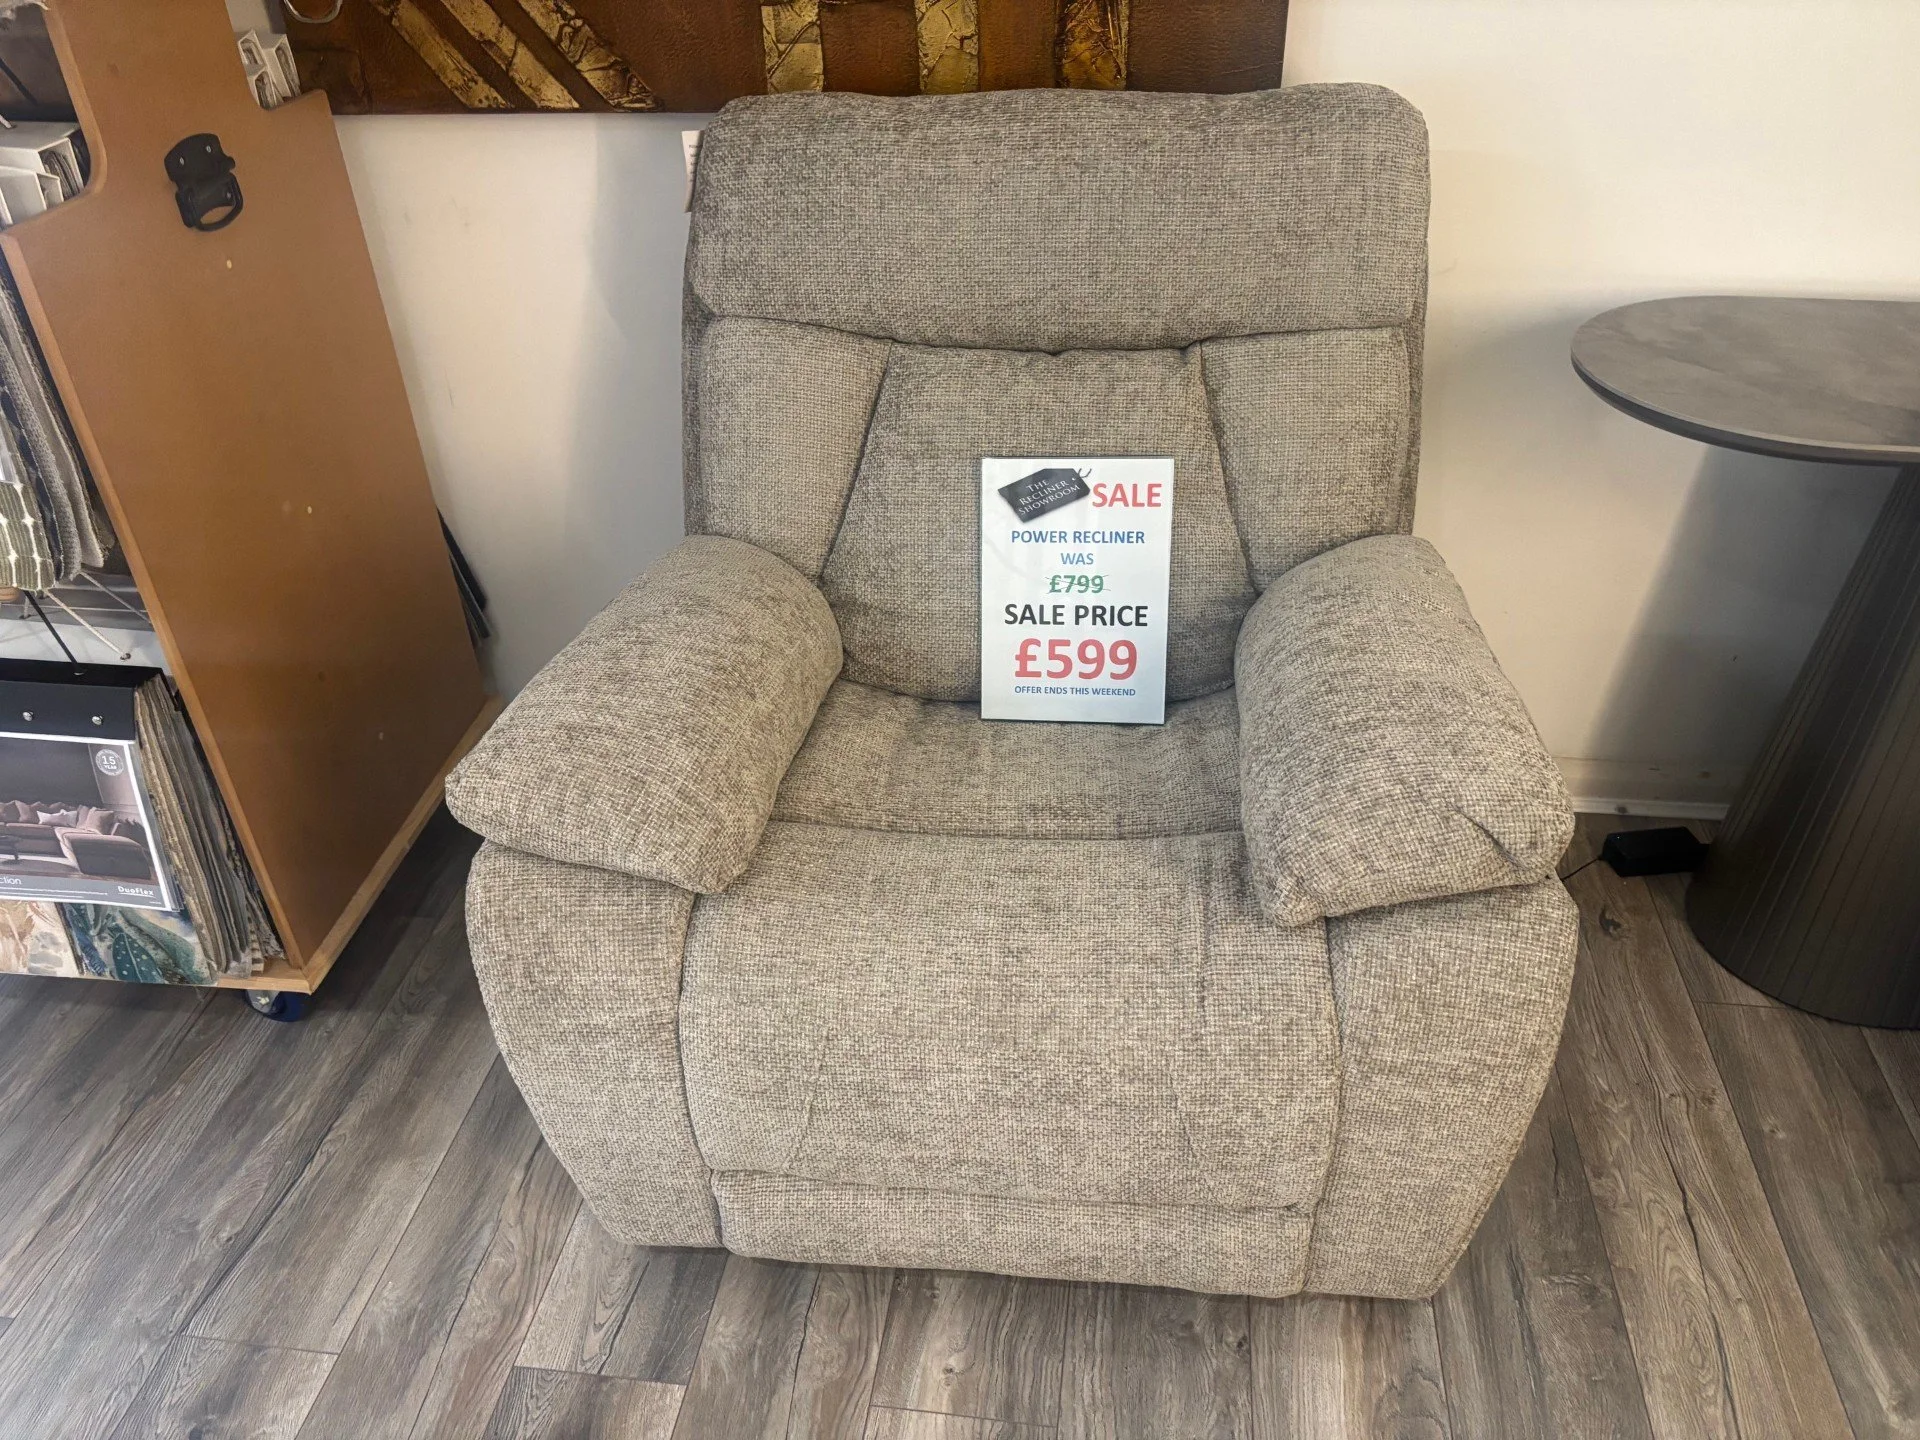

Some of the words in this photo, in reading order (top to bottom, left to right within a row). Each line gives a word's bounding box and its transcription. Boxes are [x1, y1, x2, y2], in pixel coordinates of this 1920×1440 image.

[1019, 480, 1070, 505] RECLINER
[1026, 479, 1050, 492] THE
[1092, 482, 1162, 507] SALE
[1018, 484, 1080, 515] SHOWROOM
[1011, 530, 1068, 543] POWER
[1073, 531, 1145, 544] RECLINER
[1060, 552, 1094, 565] WAS
[1049, 574, 1104, 594] £799
[1004, 603, 1065, 626] SALE
[1074, 605, 1148, 627] PRICE
[1015, 638, 1137, 680] £599
[1014, 685, 1042, 694] OFFER
[1044, 686, 1068, 695] ENDS
[1069, 687, 1089, 695] THIS
[1091, 687, 1136, 696] WEEKEND
[102, 755, 116, 765] 15
